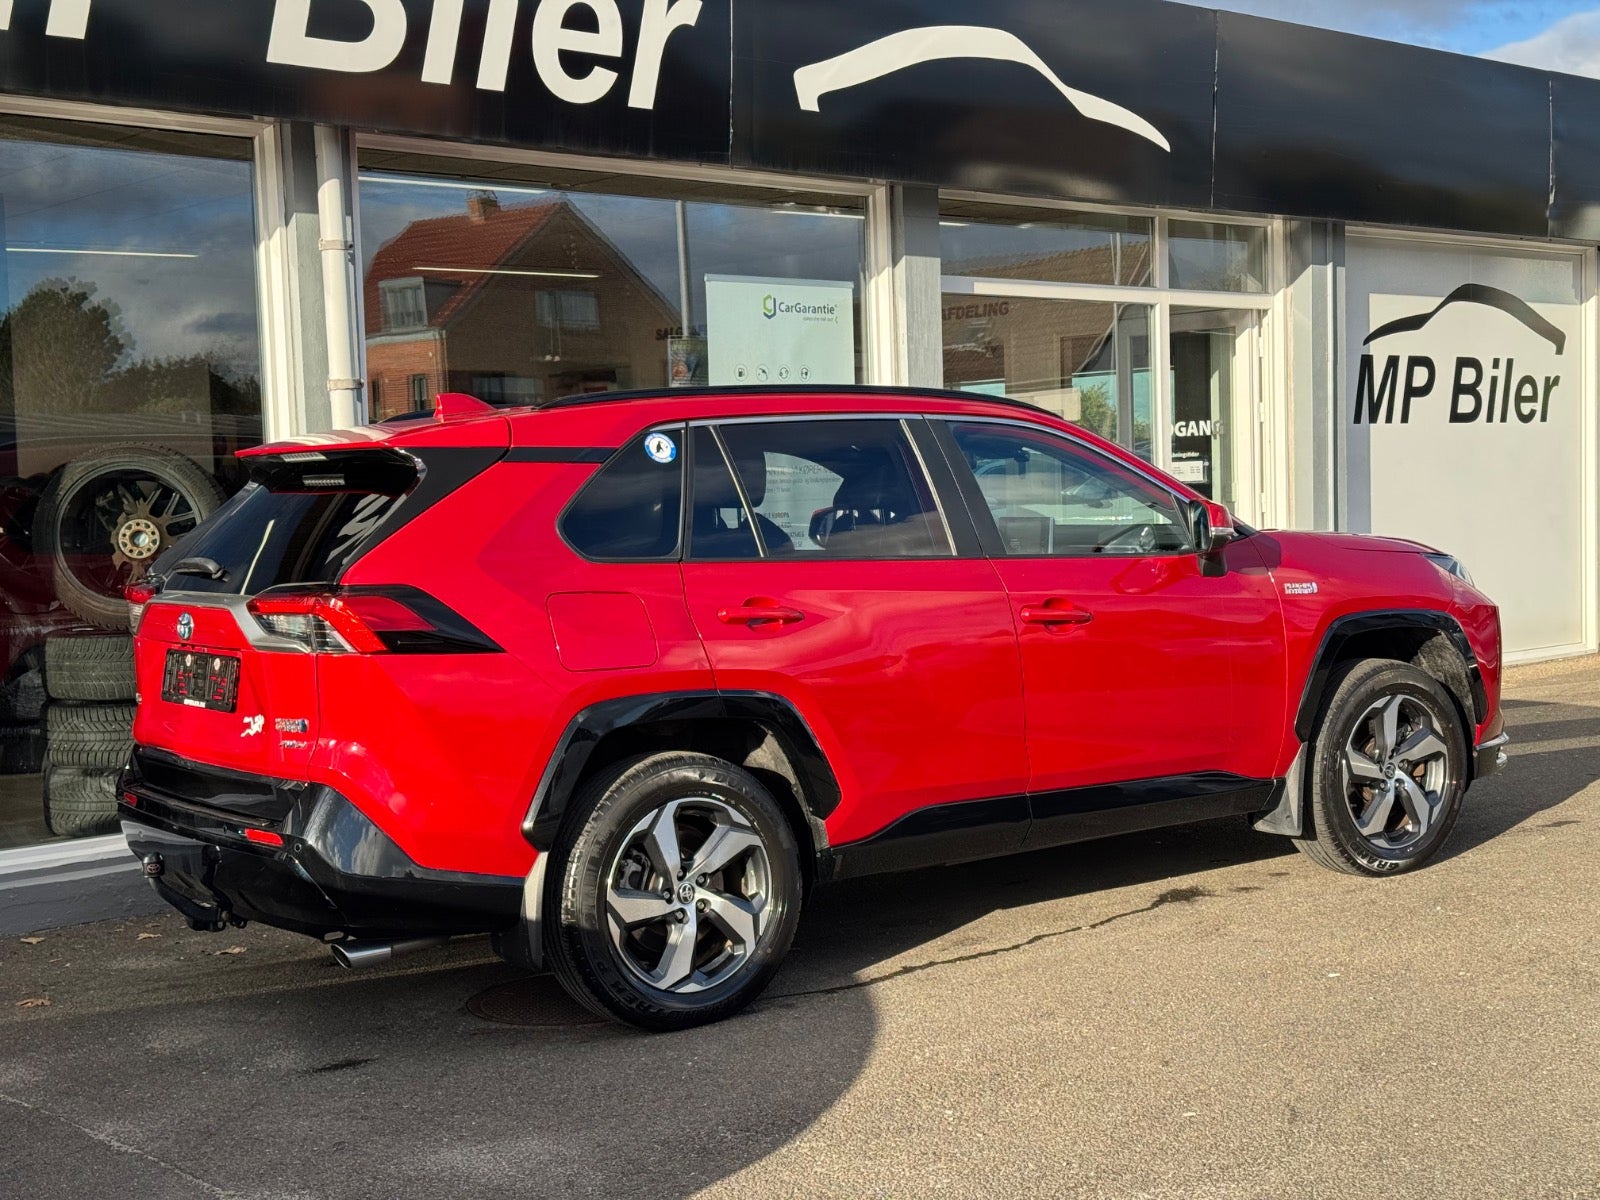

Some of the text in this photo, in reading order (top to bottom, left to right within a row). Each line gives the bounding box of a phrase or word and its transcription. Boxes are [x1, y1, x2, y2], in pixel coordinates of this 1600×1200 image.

[778, 302, 836, 315] CarGarantie
[1353, 353, 1561, 424] MP Biler
